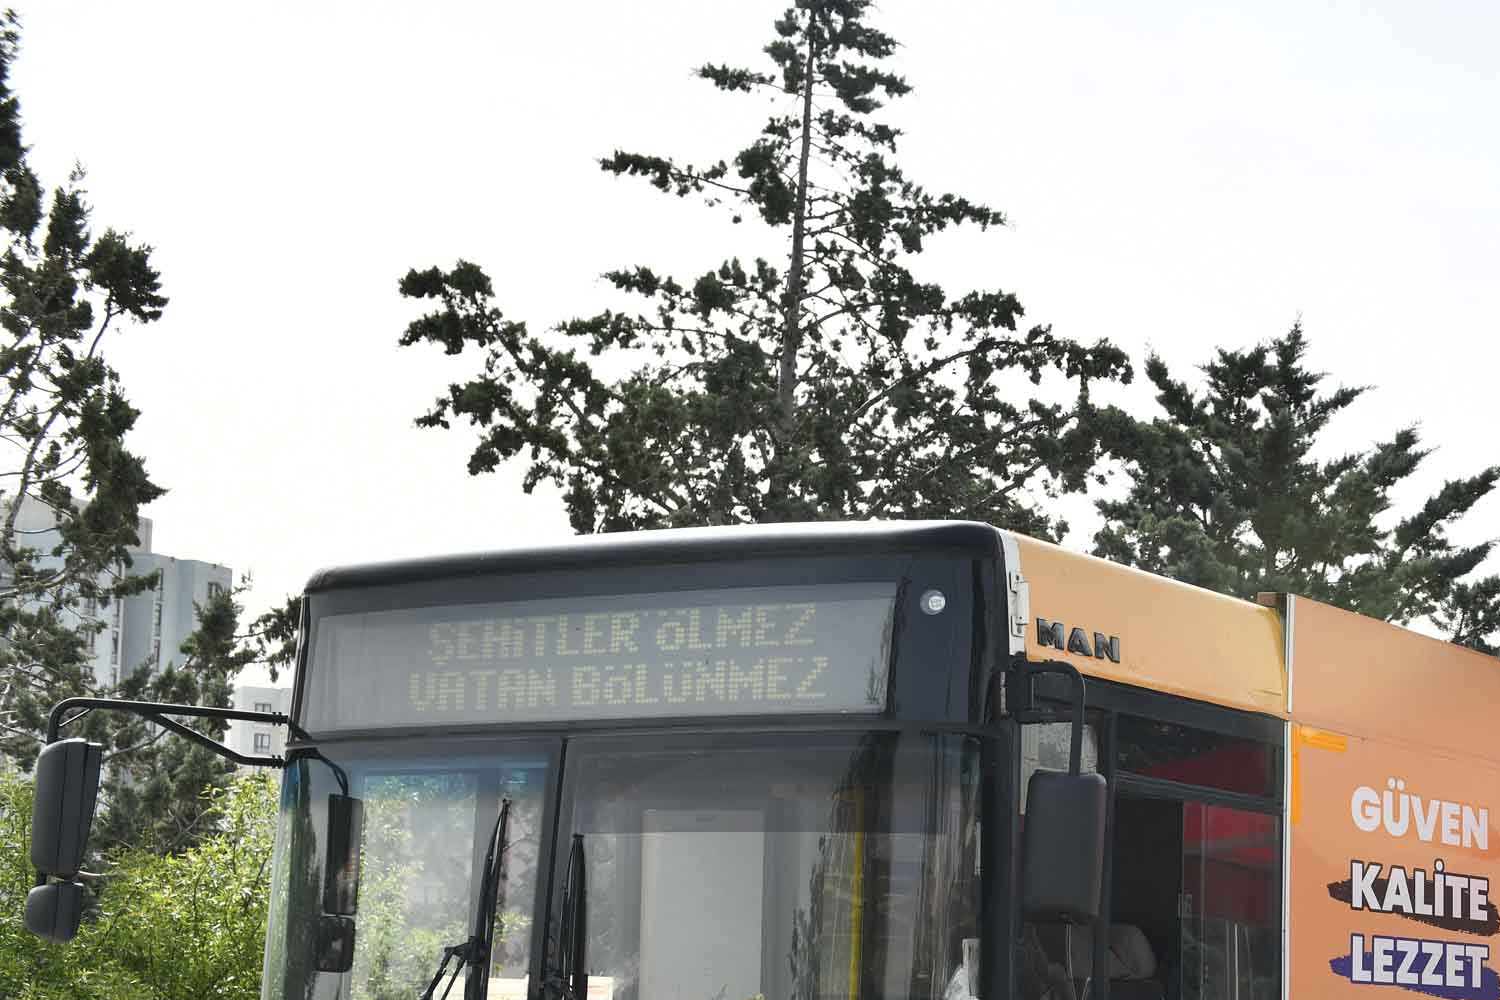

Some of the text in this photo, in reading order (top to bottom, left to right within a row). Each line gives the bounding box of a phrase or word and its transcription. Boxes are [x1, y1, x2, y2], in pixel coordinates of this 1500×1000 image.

[1036, 617, 1120, 663] MAN
[408, 667, 557, 711] VATAN
[1350, 776, 1489, 850] GÜVEN
[1350, 858, 1489, 922] KALİTE
[1350, 933, 1489, 989] LEZZET
